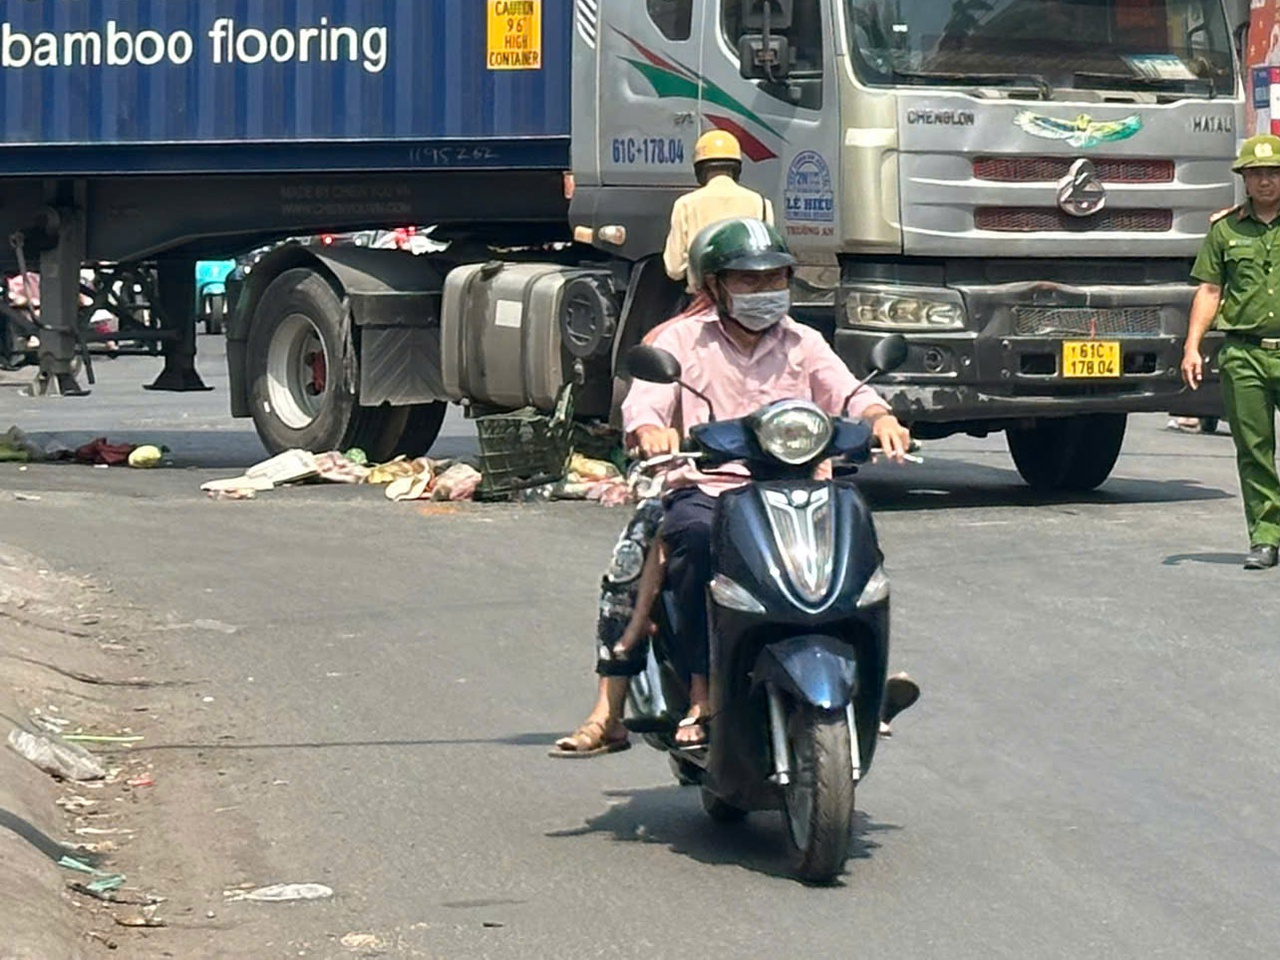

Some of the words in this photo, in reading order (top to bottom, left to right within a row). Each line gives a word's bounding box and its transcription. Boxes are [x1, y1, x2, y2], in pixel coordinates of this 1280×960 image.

[1, 20, 193, 68] bamboo
[208, 16, 389, 74] flooring
[504, 34, 528, 49] HIGH
